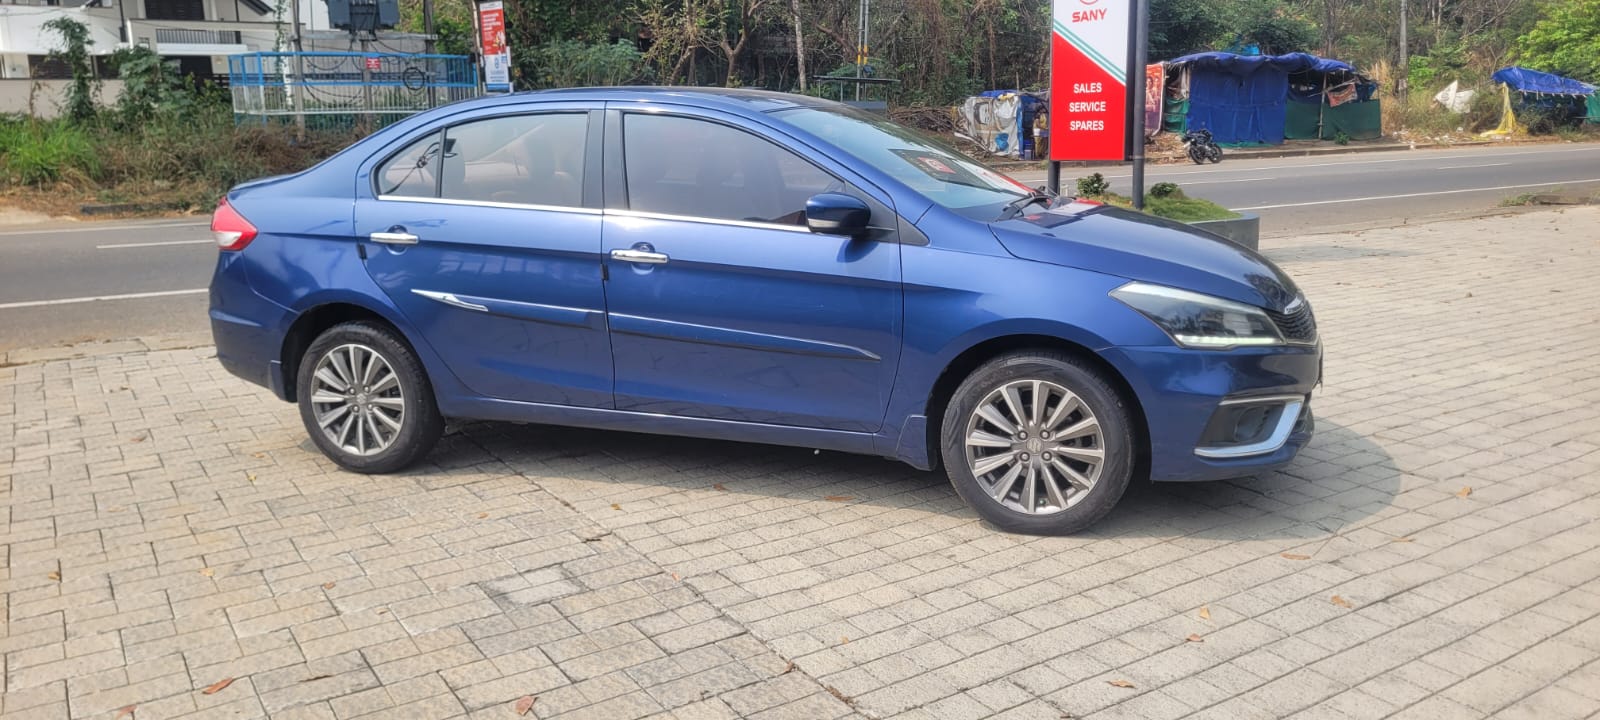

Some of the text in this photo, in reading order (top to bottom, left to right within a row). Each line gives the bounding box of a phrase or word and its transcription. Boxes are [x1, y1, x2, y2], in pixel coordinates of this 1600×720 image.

[1072, 8, 1107, 23] SANY
[1073, 82, 1102, 94] SALES
[1069, 101, 1106, 112] SERVICE
[1070, 120, 1104, 131] SPARES
